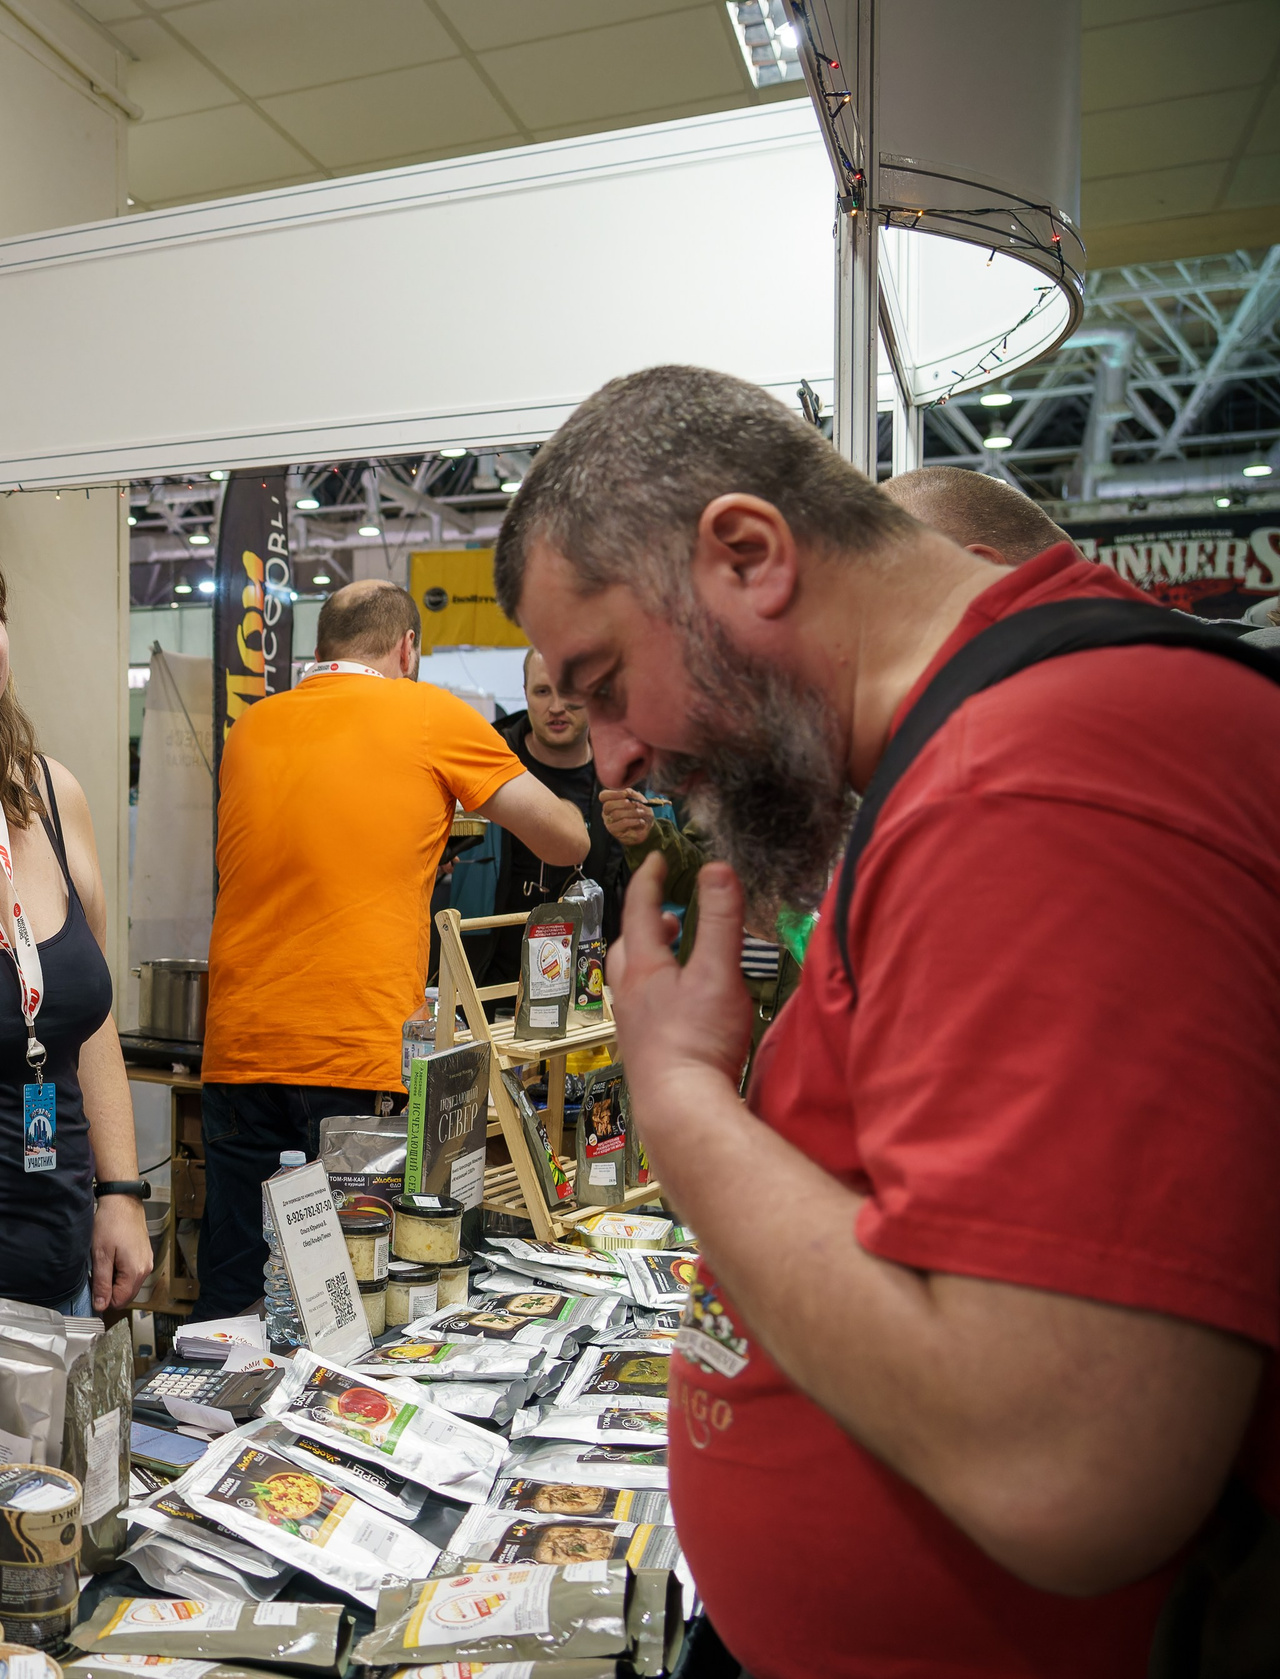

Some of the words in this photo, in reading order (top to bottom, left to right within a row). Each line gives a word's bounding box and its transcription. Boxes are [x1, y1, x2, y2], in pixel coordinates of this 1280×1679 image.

[438, 1102, 478, 1144] СЕВЕР
[408, 1101, 421, 1172] ИСЧЕЗАЮЩИЙ
[27, 1155, 54, 1169] УЧАСТНИК
[329, 1175, 365, 1183] ТОМ-ЯМ-КАЙ
[286, 1199, 332, 1226] 8-926-782-87-50
[298, 1440, 335, 1463] Удобная
[217, 1477, 234, 1495] ПЛОВ
[353, 1464, 390, 1491] БОРЩ
